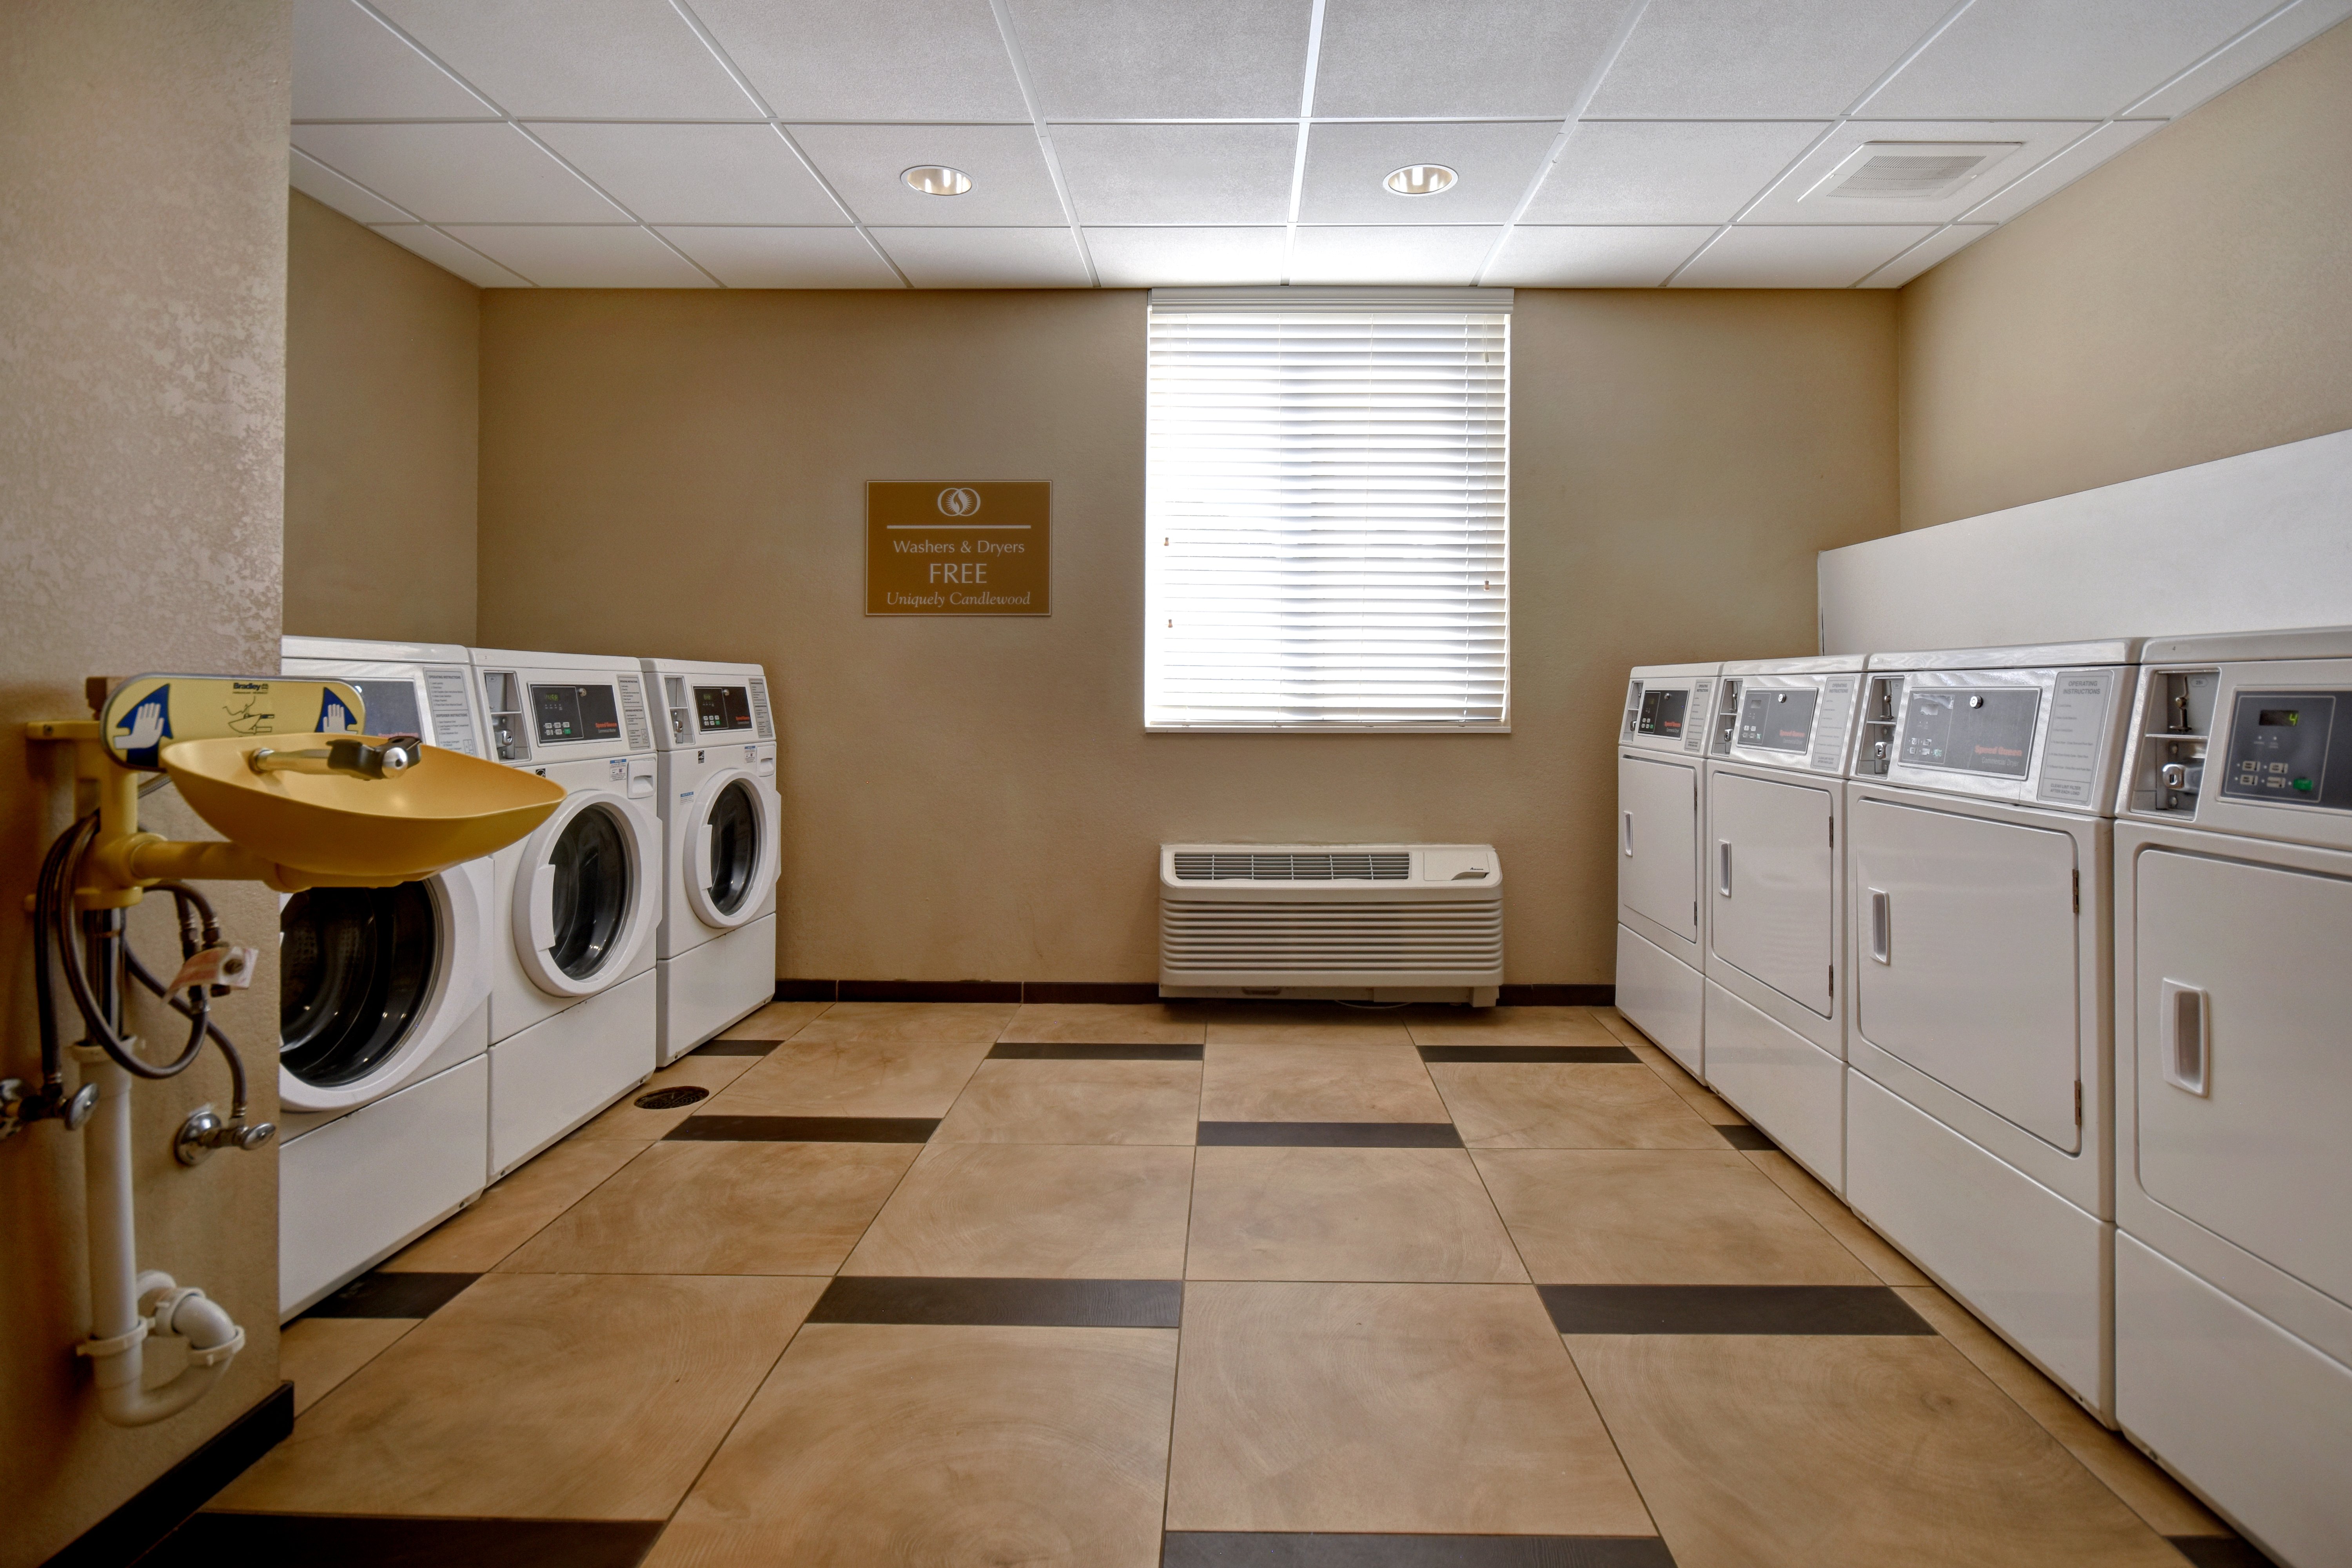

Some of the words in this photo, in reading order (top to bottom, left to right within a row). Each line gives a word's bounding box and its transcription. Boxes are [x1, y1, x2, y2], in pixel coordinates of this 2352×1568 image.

[893, 539, 955, 553] Washers
[961, 541, 971, 553] &
[978, 540, 1025, 557] Dryers
[930, 563, 987, 583] FREE
[887, 592, 945, 608] Uniquely
[949, 592, 1031, 605] Candlewood
[233, 682, 260, 691] Bradley
[2290, 713, 2298, 726] 4
[1975, 745, 1998, 755] Speed
[1998, 746, 2022, 756] Queen
[1982, 757, 2006, 766] Commercial
[2007, 759, 2019, 767] Dryer
